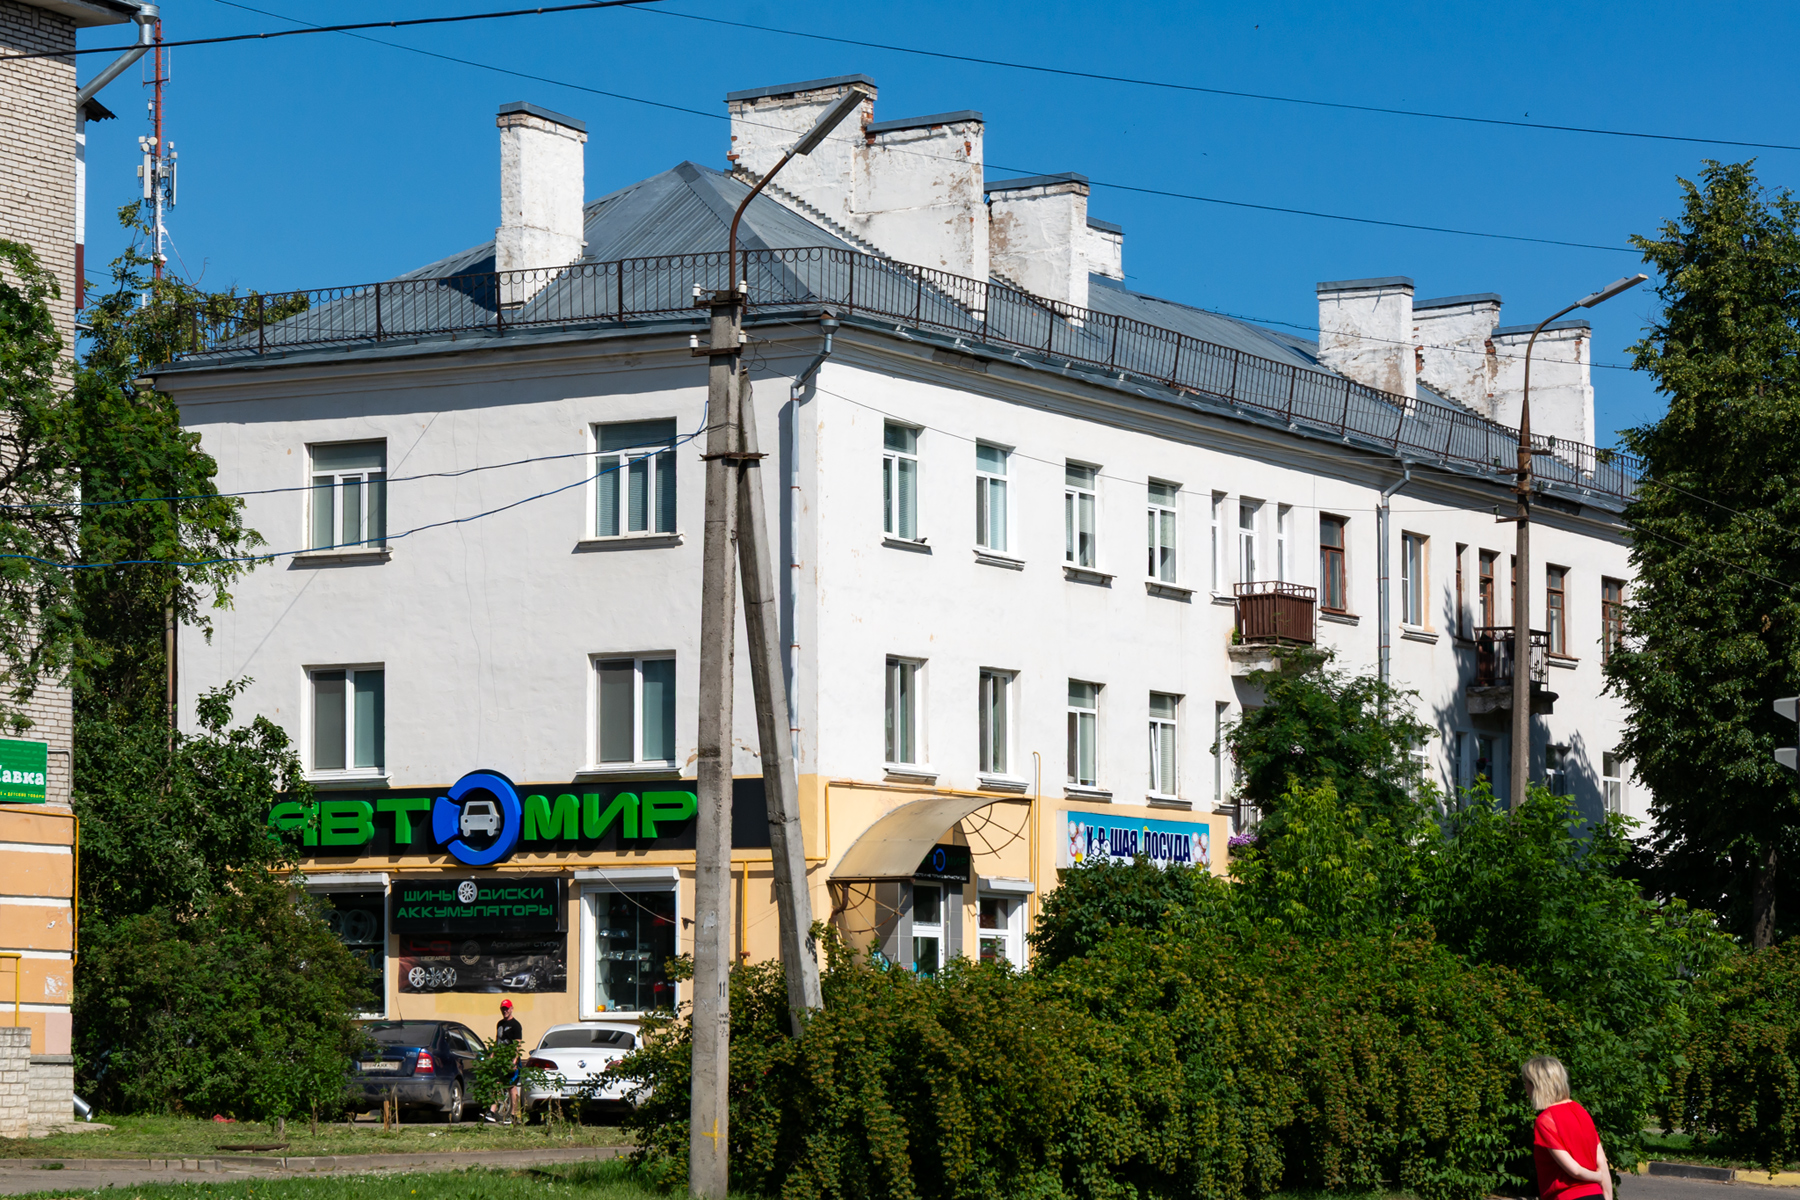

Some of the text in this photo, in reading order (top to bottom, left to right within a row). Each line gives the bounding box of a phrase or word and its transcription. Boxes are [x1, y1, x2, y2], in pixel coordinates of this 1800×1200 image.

[1143, 830, 1191, 862] ПОСУДА
[403, 887, 544, 903] ШИНЫ ДИСКИ
[396, 904, 554, 919] АККУМУЛЯТОРЫ
